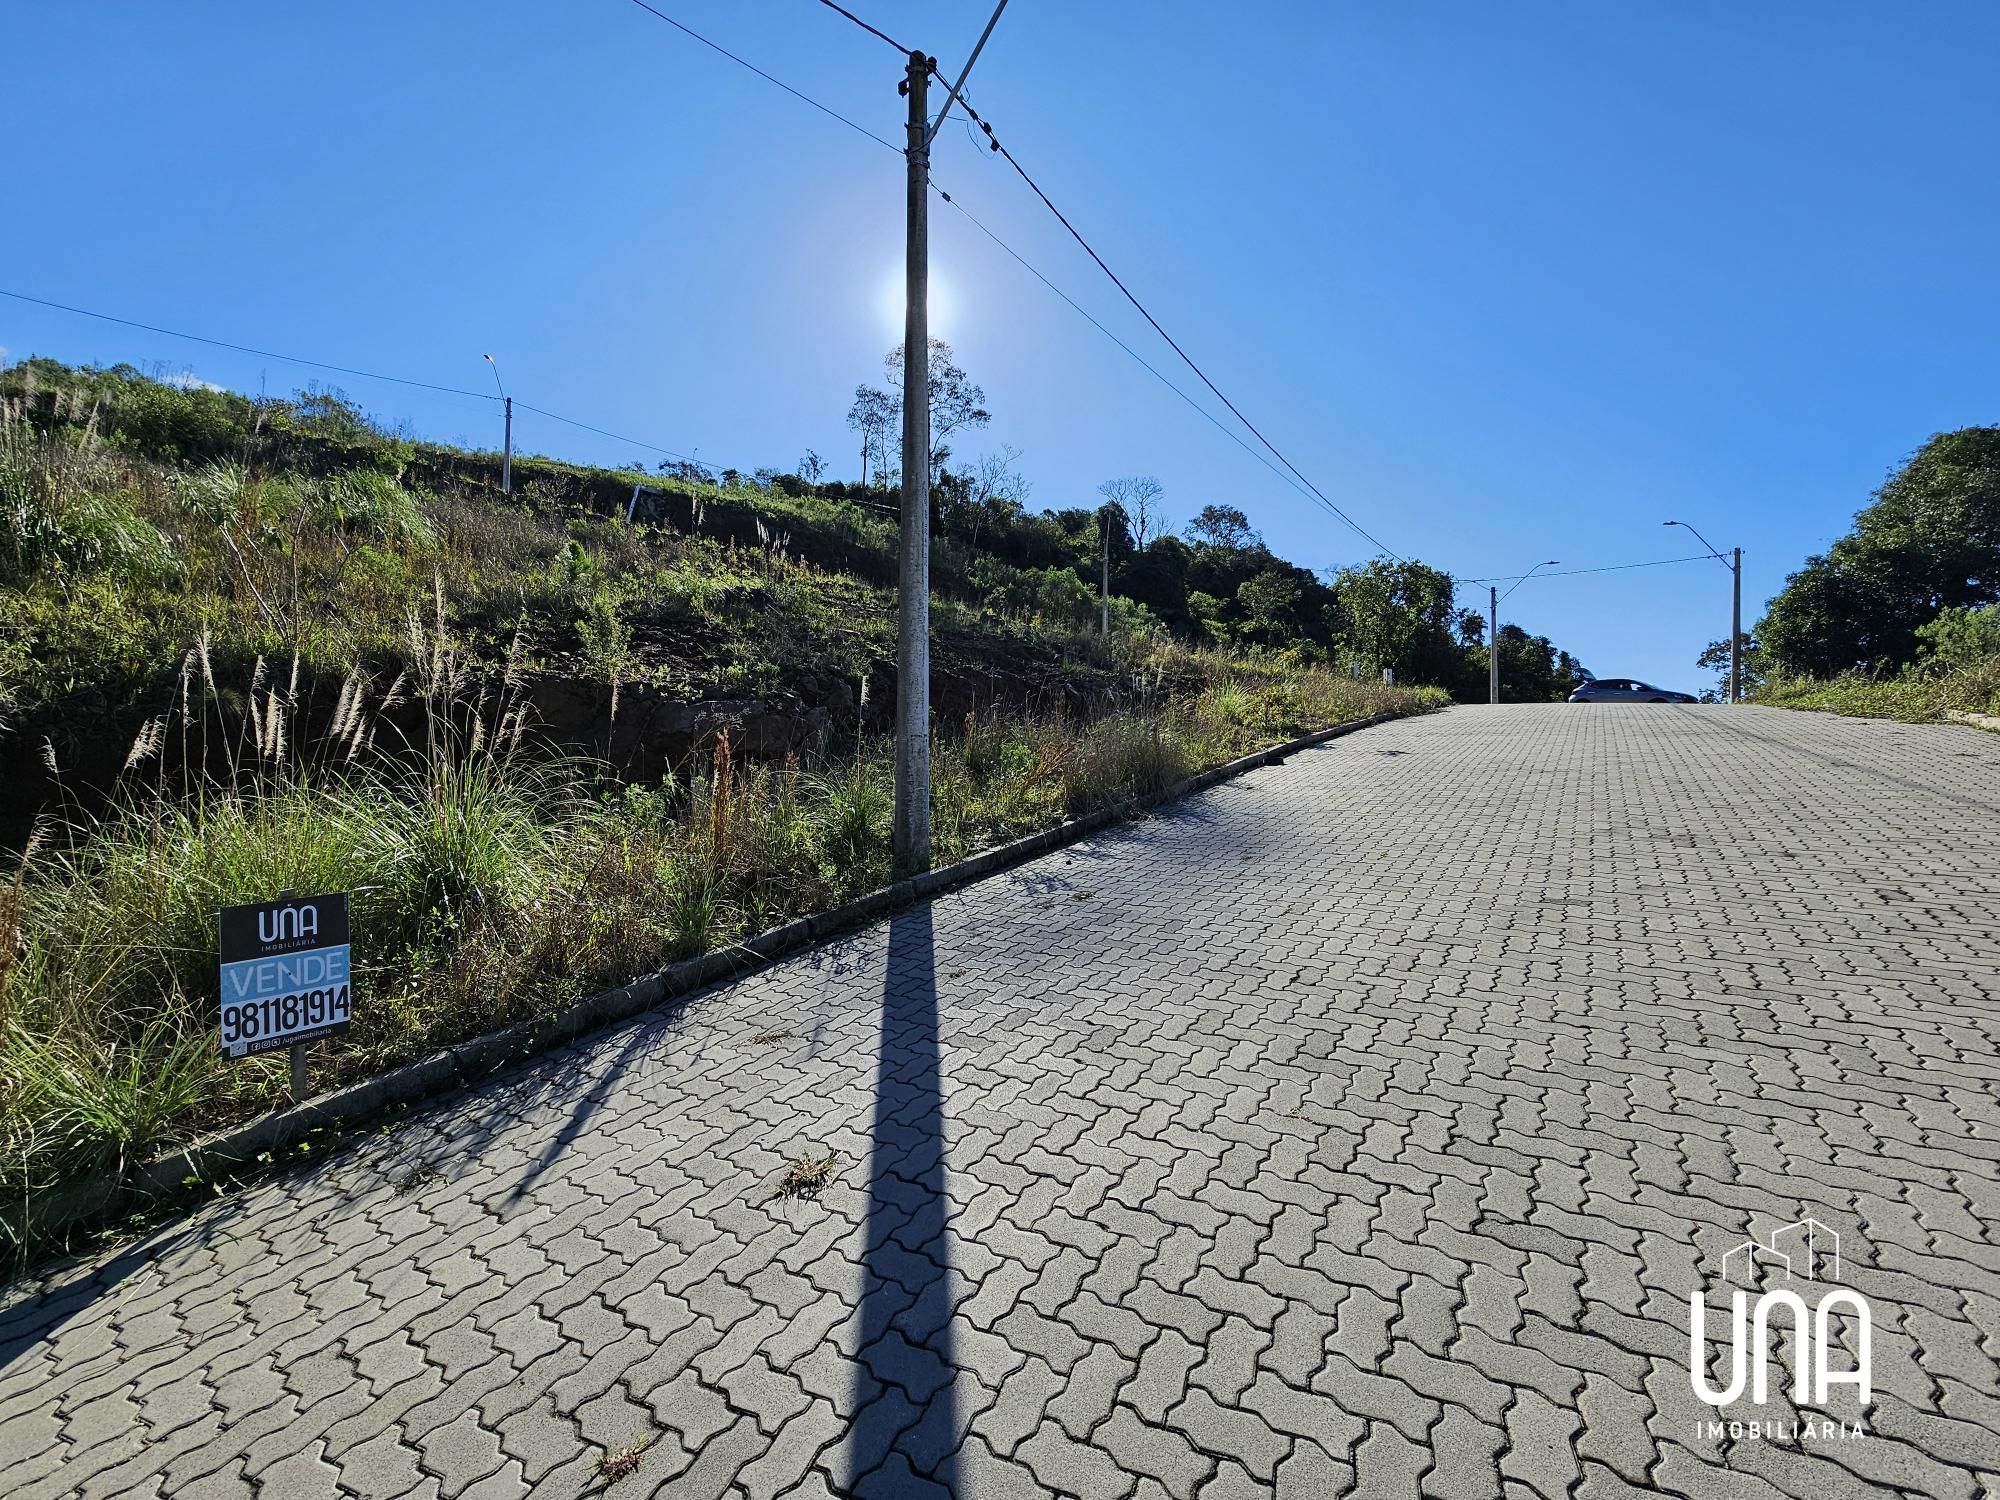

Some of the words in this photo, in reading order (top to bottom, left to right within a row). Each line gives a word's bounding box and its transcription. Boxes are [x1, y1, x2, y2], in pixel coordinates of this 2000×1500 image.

[258, 904, 318, 943] UNA
[261, 938, 317, 953] IMOBILIÁRIA
[229, 951, 344, 997] VENDE
